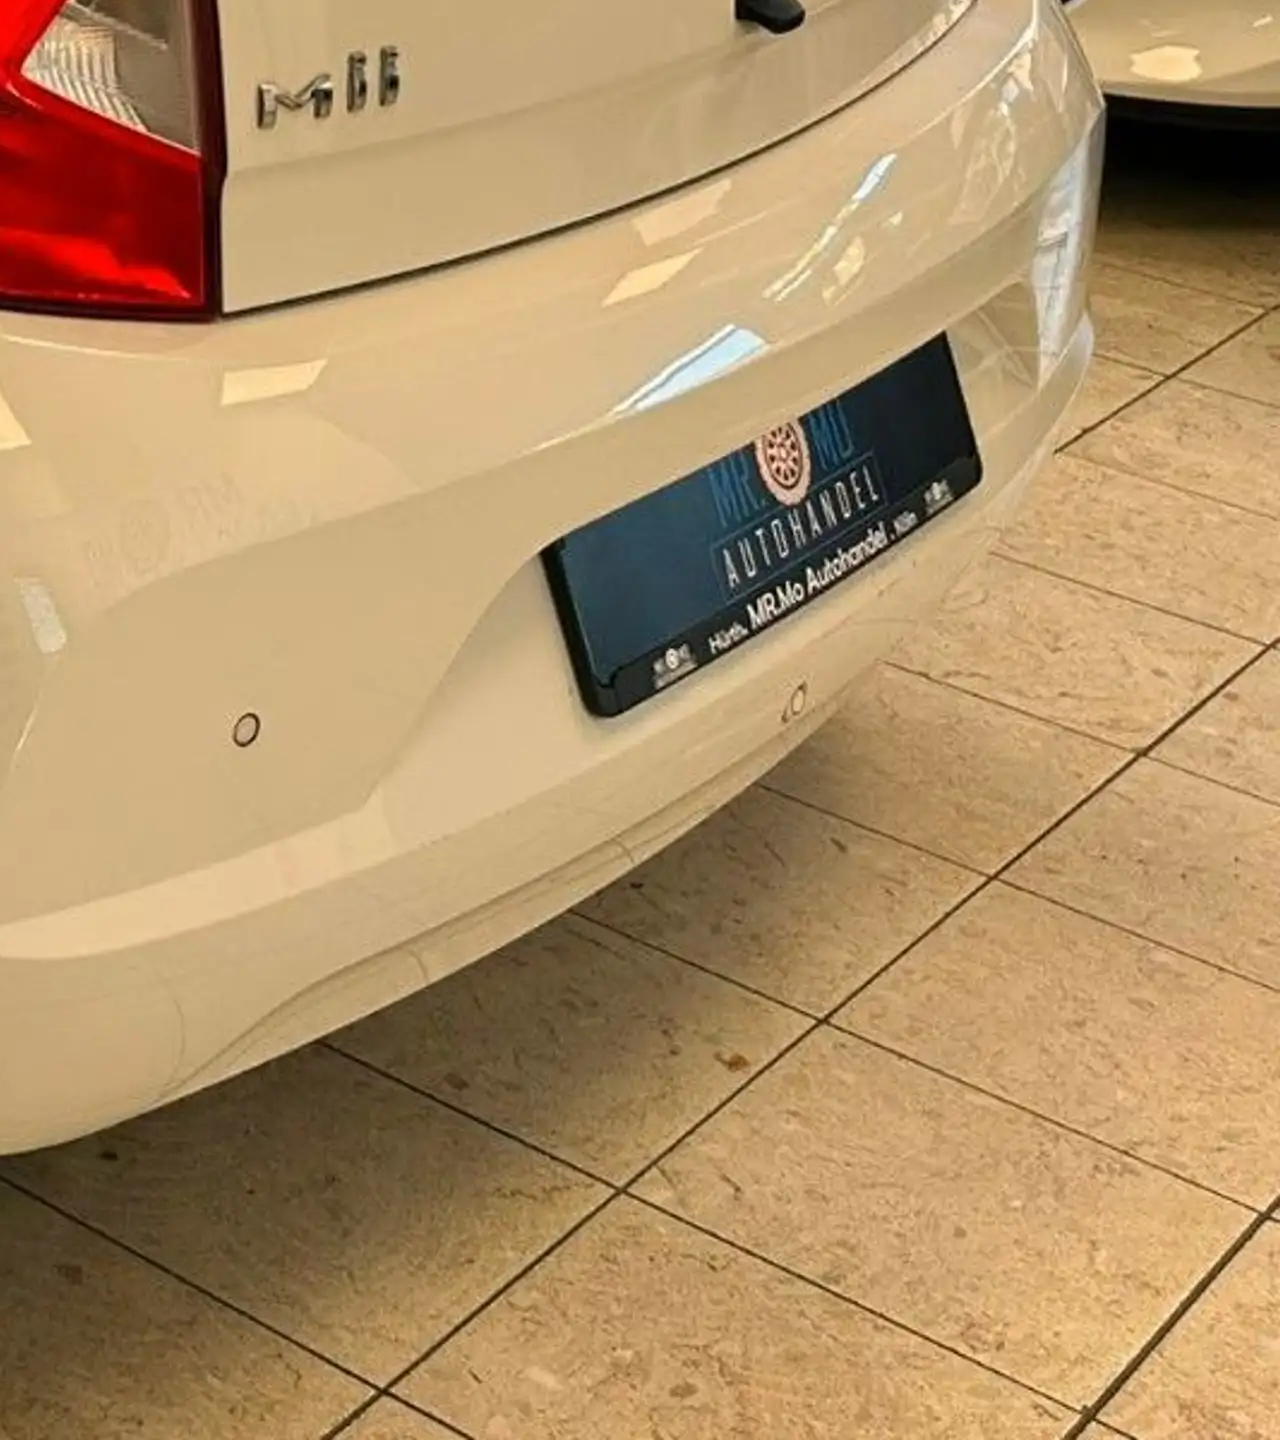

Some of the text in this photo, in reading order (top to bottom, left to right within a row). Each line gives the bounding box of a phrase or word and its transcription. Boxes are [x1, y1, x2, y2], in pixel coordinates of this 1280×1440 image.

[257, 45, 399, 129] Mii
[722, 464, 879, 589] AUTOHANDEL
[805, 521, 888, 595] Autohandel
